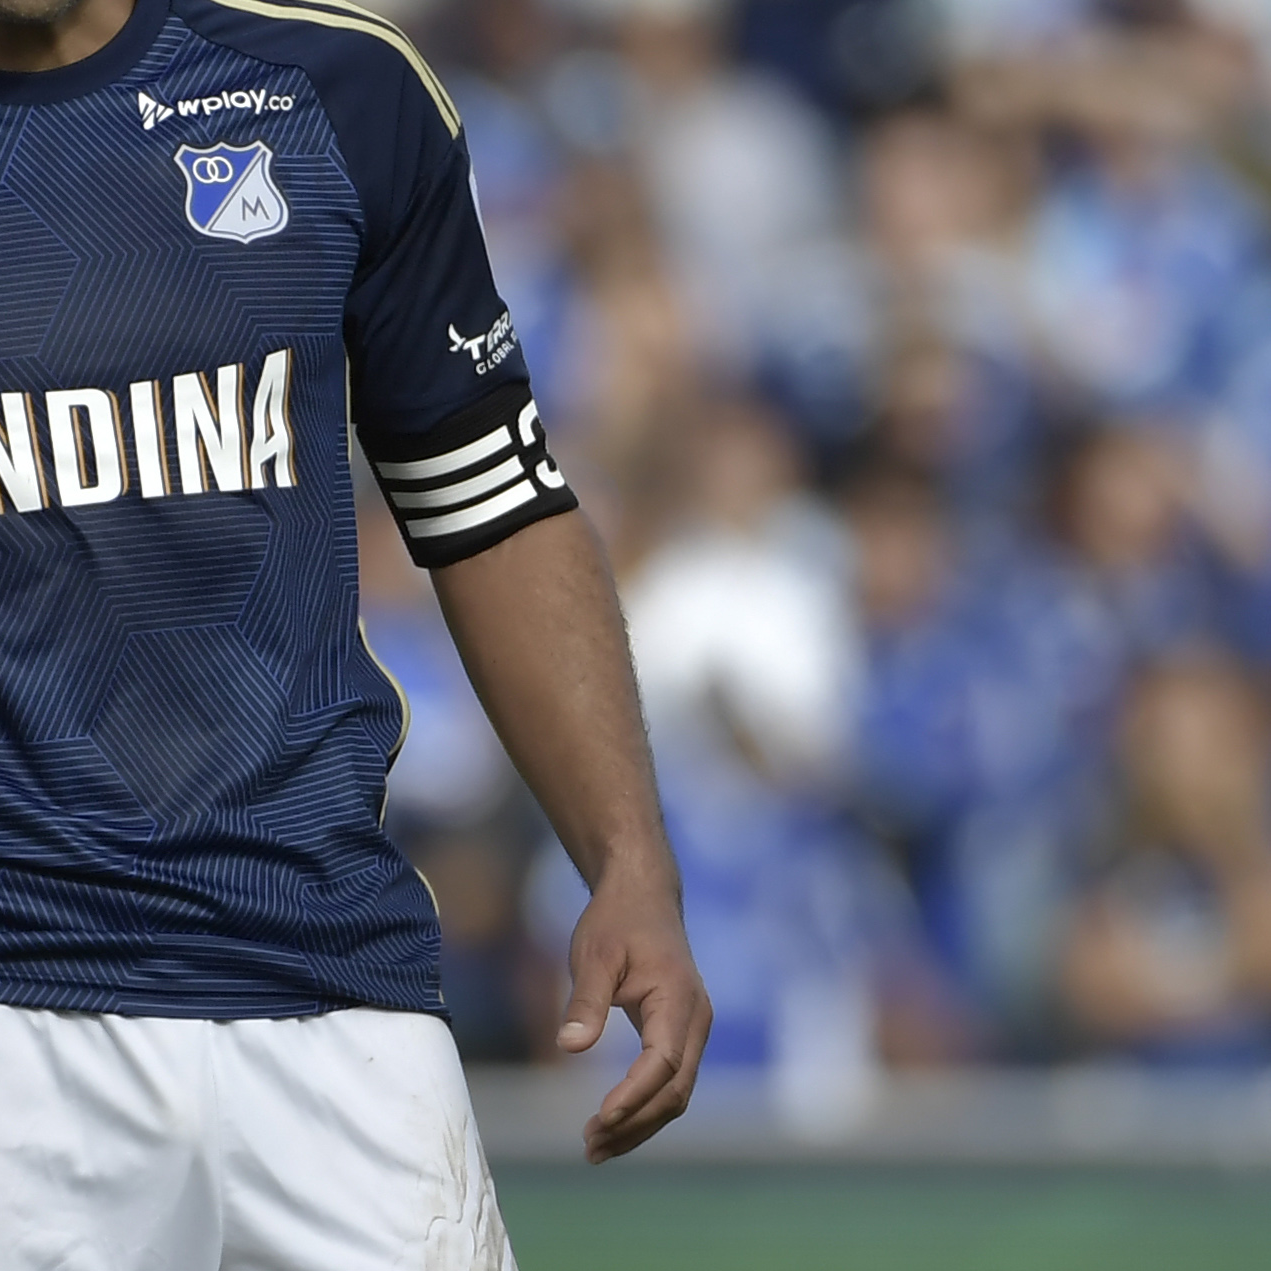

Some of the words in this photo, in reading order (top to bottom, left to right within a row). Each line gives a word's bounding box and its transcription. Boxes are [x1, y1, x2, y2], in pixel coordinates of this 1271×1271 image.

[242, 195, 270, 222] M
[462, 311, 512, 360] TERR
[475, 340, 515, 375] GLOBAL
